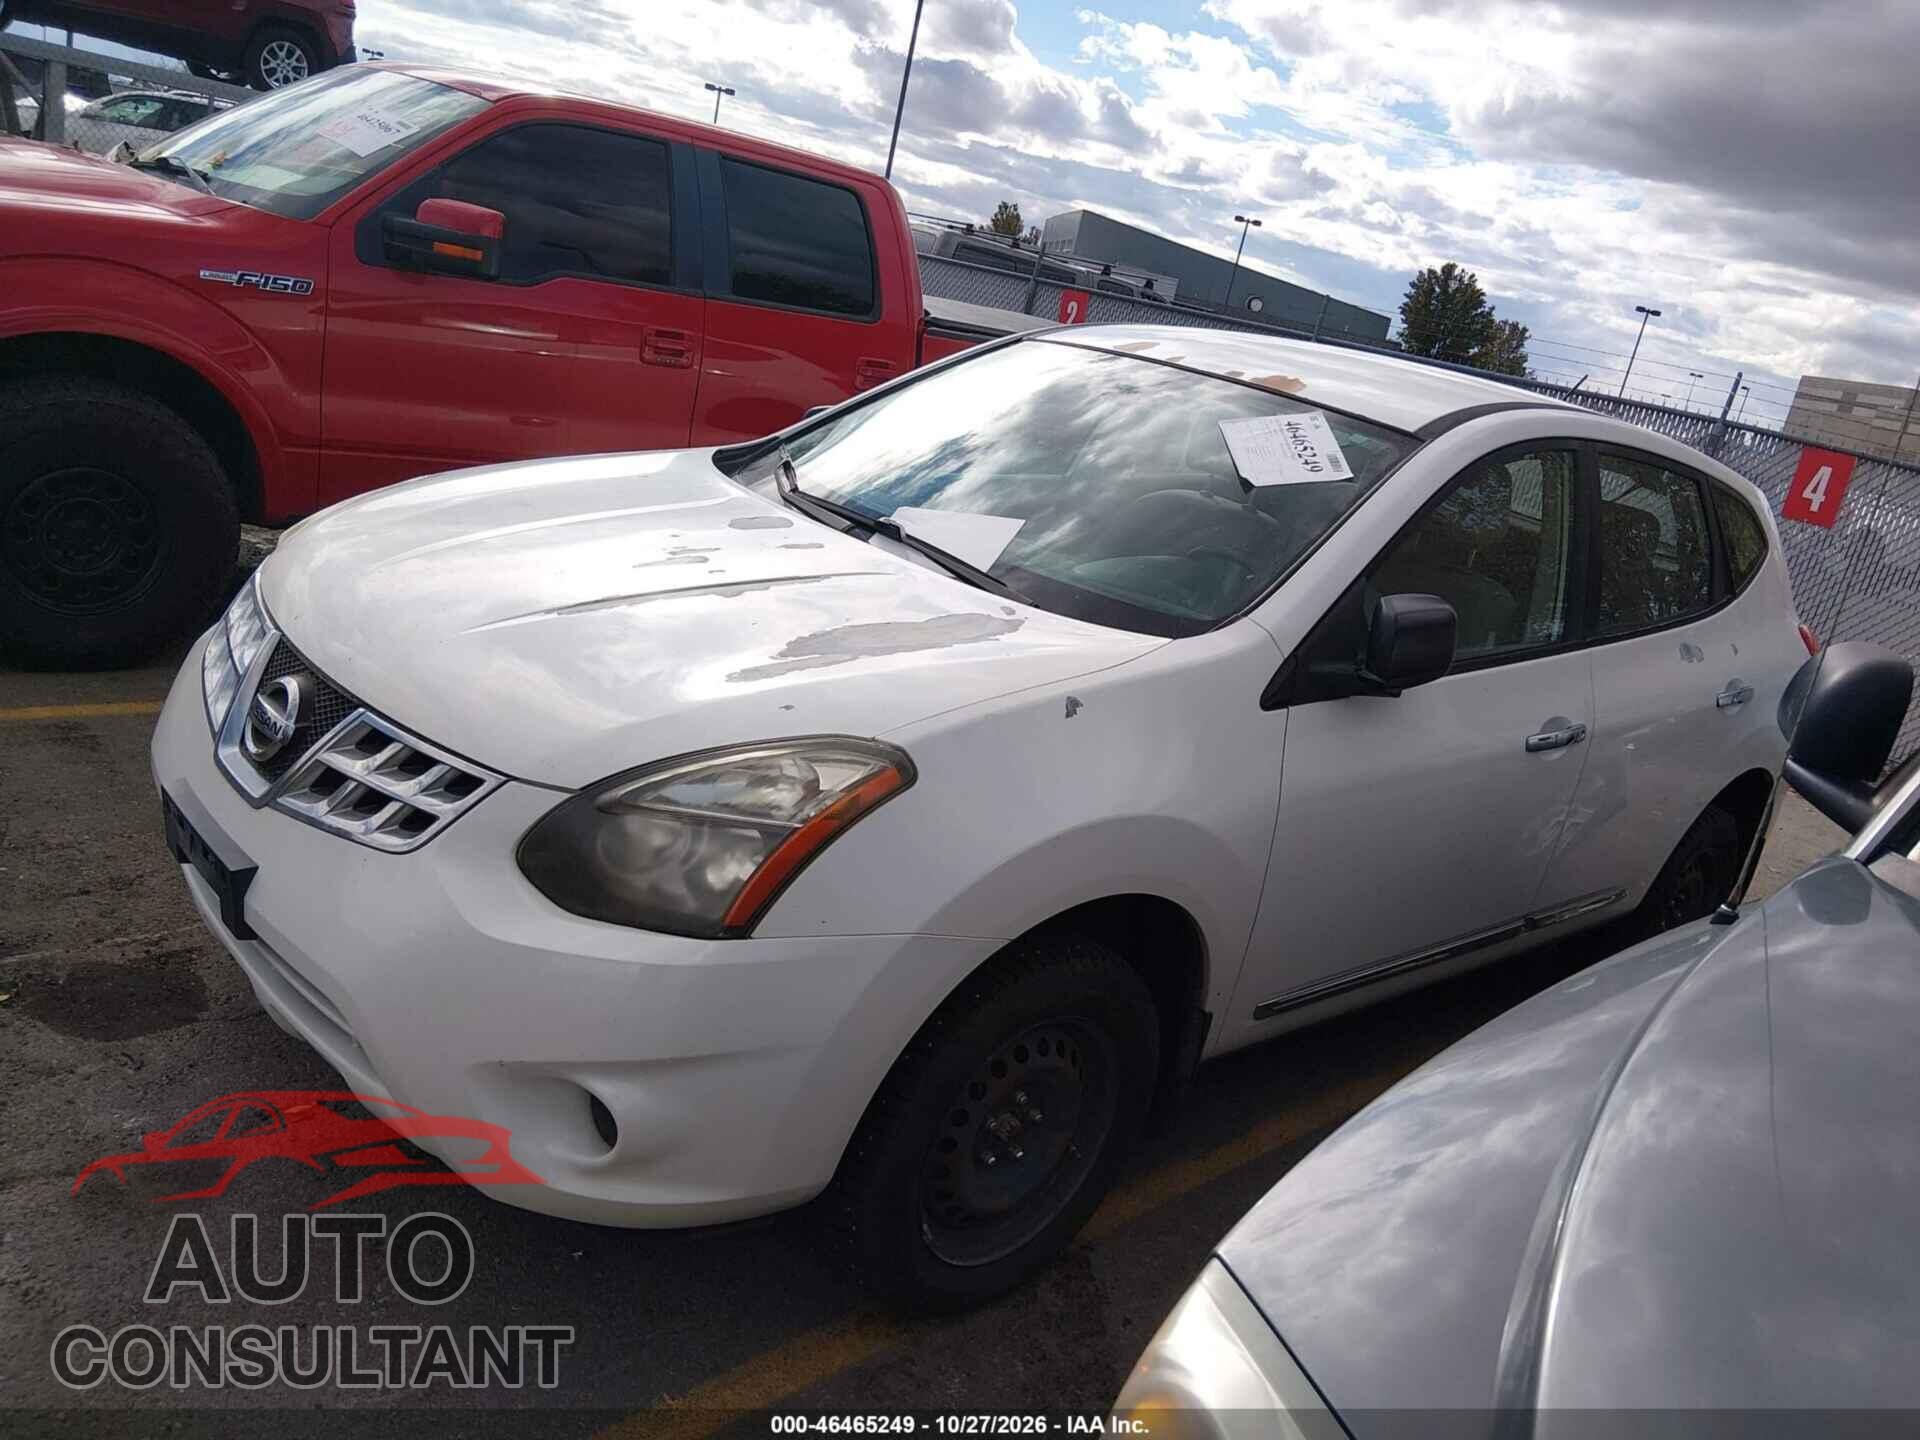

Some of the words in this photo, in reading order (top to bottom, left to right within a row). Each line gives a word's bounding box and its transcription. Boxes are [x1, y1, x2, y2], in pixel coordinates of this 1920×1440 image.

[1066, 300, 1078, 326] 2
[1284, 421, 1324, 473] 46465249
[1801, 465, 1833, 513] 4
